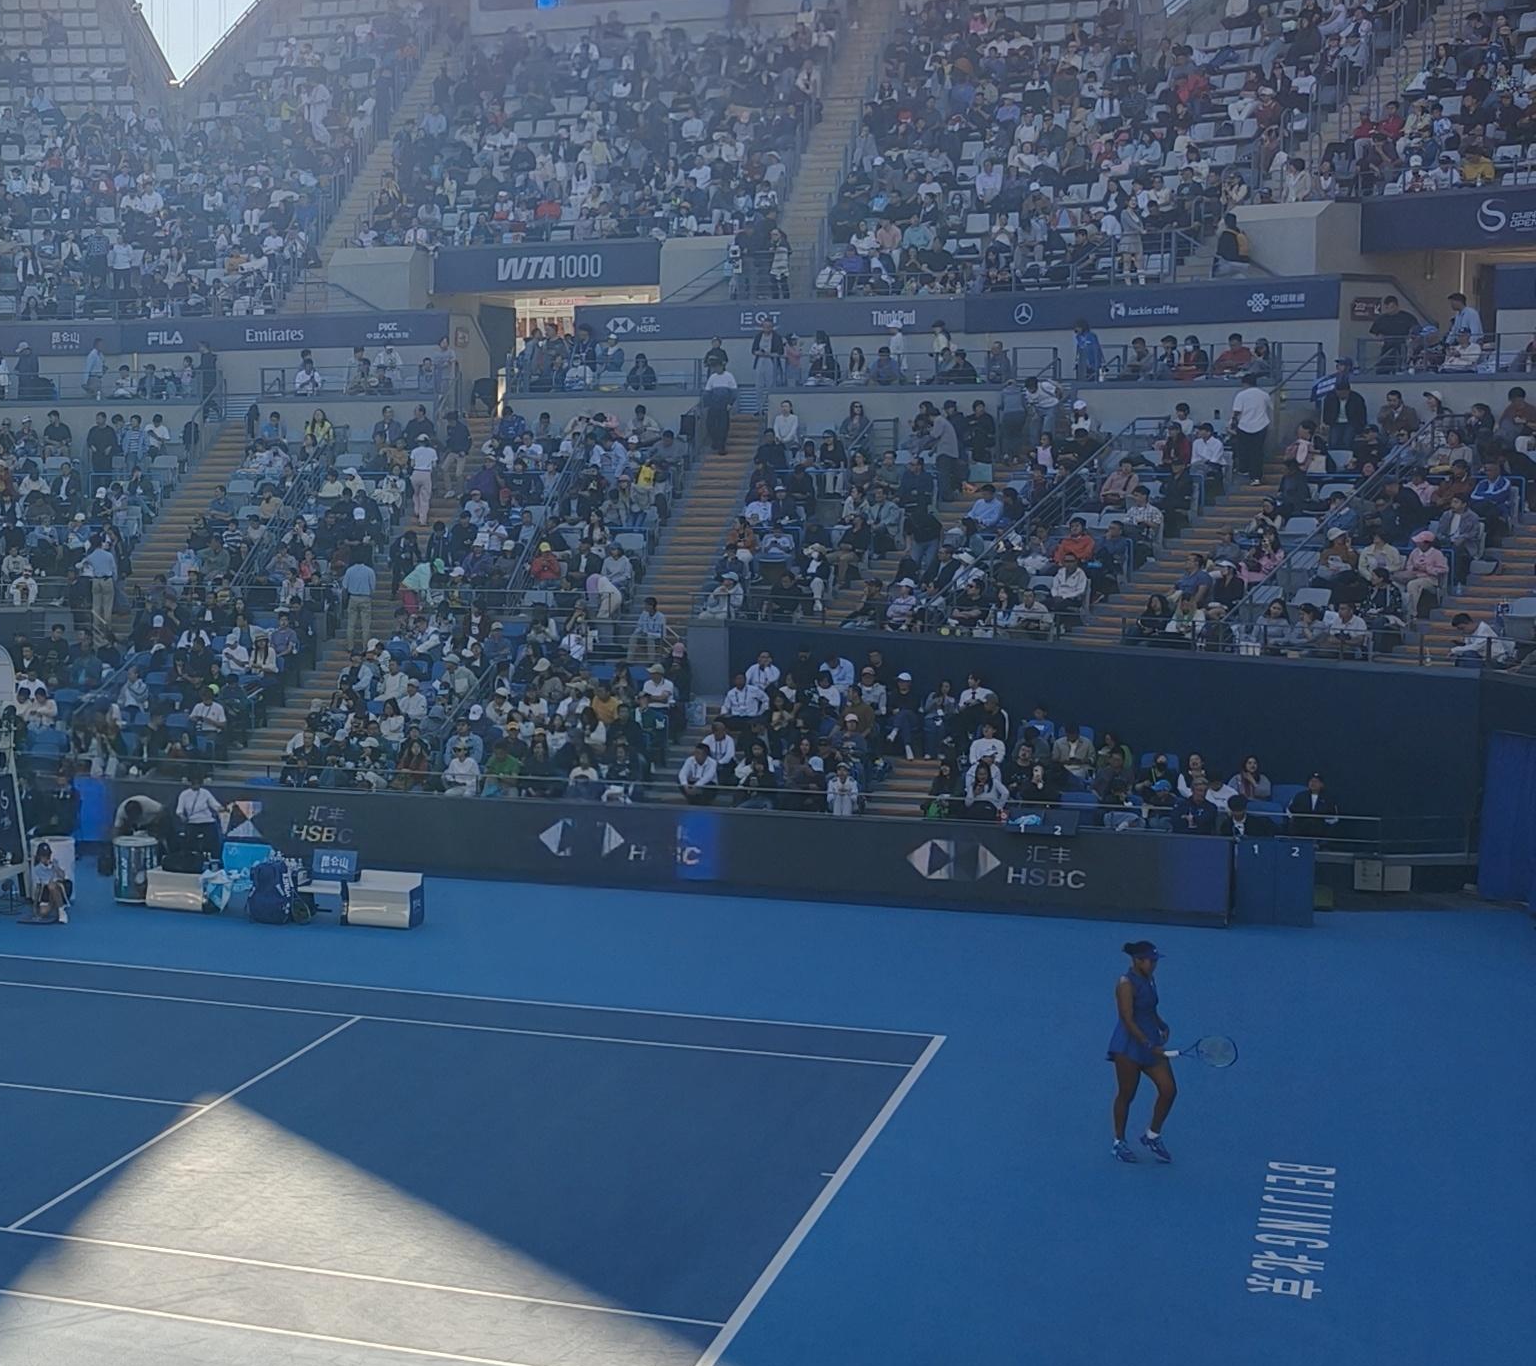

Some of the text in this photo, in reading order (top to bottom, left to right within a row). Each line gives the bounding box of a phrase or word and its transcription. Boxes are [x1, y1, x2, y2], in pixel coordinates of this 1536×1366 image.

[872, 310, 916, 326] ThinkPad
[1128, 305, 1179, 316] luckin coffee
[378, 322, 398, 332] PICC
[636, 324, 661, 333] HSBC
[147, 331, 184, 346] FILA
[245, 327, 304, 343] Emirates
[1007, 866, 1087, 889] HSBC
